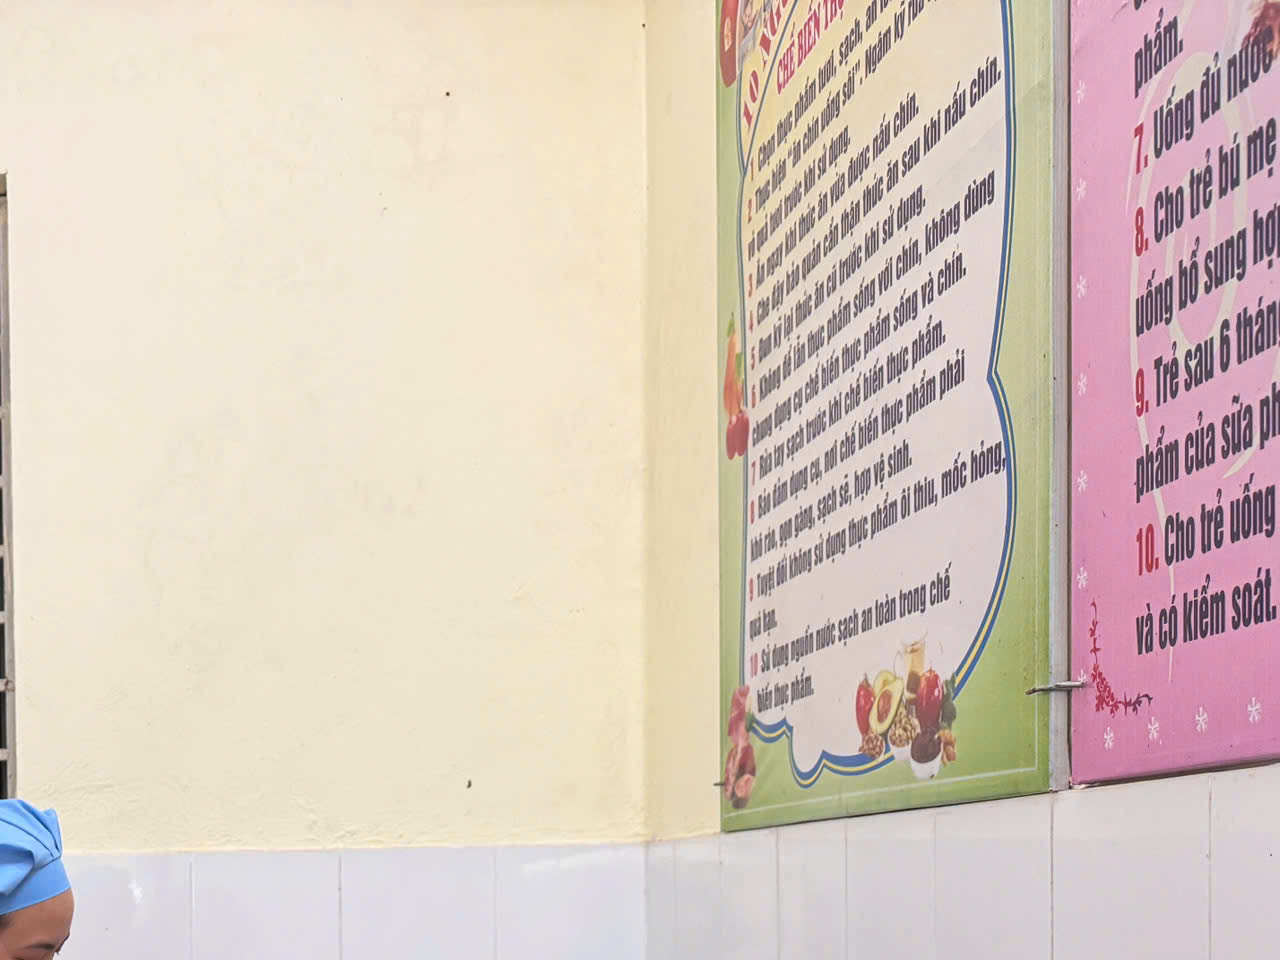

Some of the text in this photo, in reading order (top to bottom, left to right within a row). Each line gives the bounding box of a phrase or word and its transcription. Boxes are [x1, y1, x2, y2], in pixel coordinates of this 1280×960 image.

[775, 21, 796, 95] CHẾ
[863, 24, 892, 79] Ngâm
[1134, 7, 1183, 99] phẩm.
[846, 91, 919, 189] được nấu chín.
[861, 55, 1001, 218] thức ăn sau khi nấu chín.
[1134, 122, 1148, 175] 7.
[1153, 85, 1195, 160] Uống
[1200, 51, 1221, 124] đủ
[863, 183, 926, 263] khi sử dụng.
[1134, 117, 1277, 257] 8. Cho trẻ bú mẹ
[852, 168, 995, 319] sống với chín, không dùng
[1135, 202, 1280, 338] uống bổ sung hợ
[862, 249, 967, 360] phẩm sống và chín.
[1135, 295, 1280, 418] 9. Trẻ sau 6 thán
[857, 347, 965, 451] biến thực phẩm phải
[862, 313, 947, 402] biến thực phẩm.
[847, 438, 1007, 549] thực phẩm ôi thiu, mốc hỏng,
[853, 438, 913, 502] hợp vệ sinh.
[1135, 424, 1180, 505] phẩm
[1184, 410, 1216, 476] của
[1220, 393, 1254, 461] sữa
[1135, 472, 1276, 577] 10. Cho trẻ uống
[860, 560, 952, 633] an toàn trong chế
[1135, 567, 1277, 656] và có kiểm soát.
